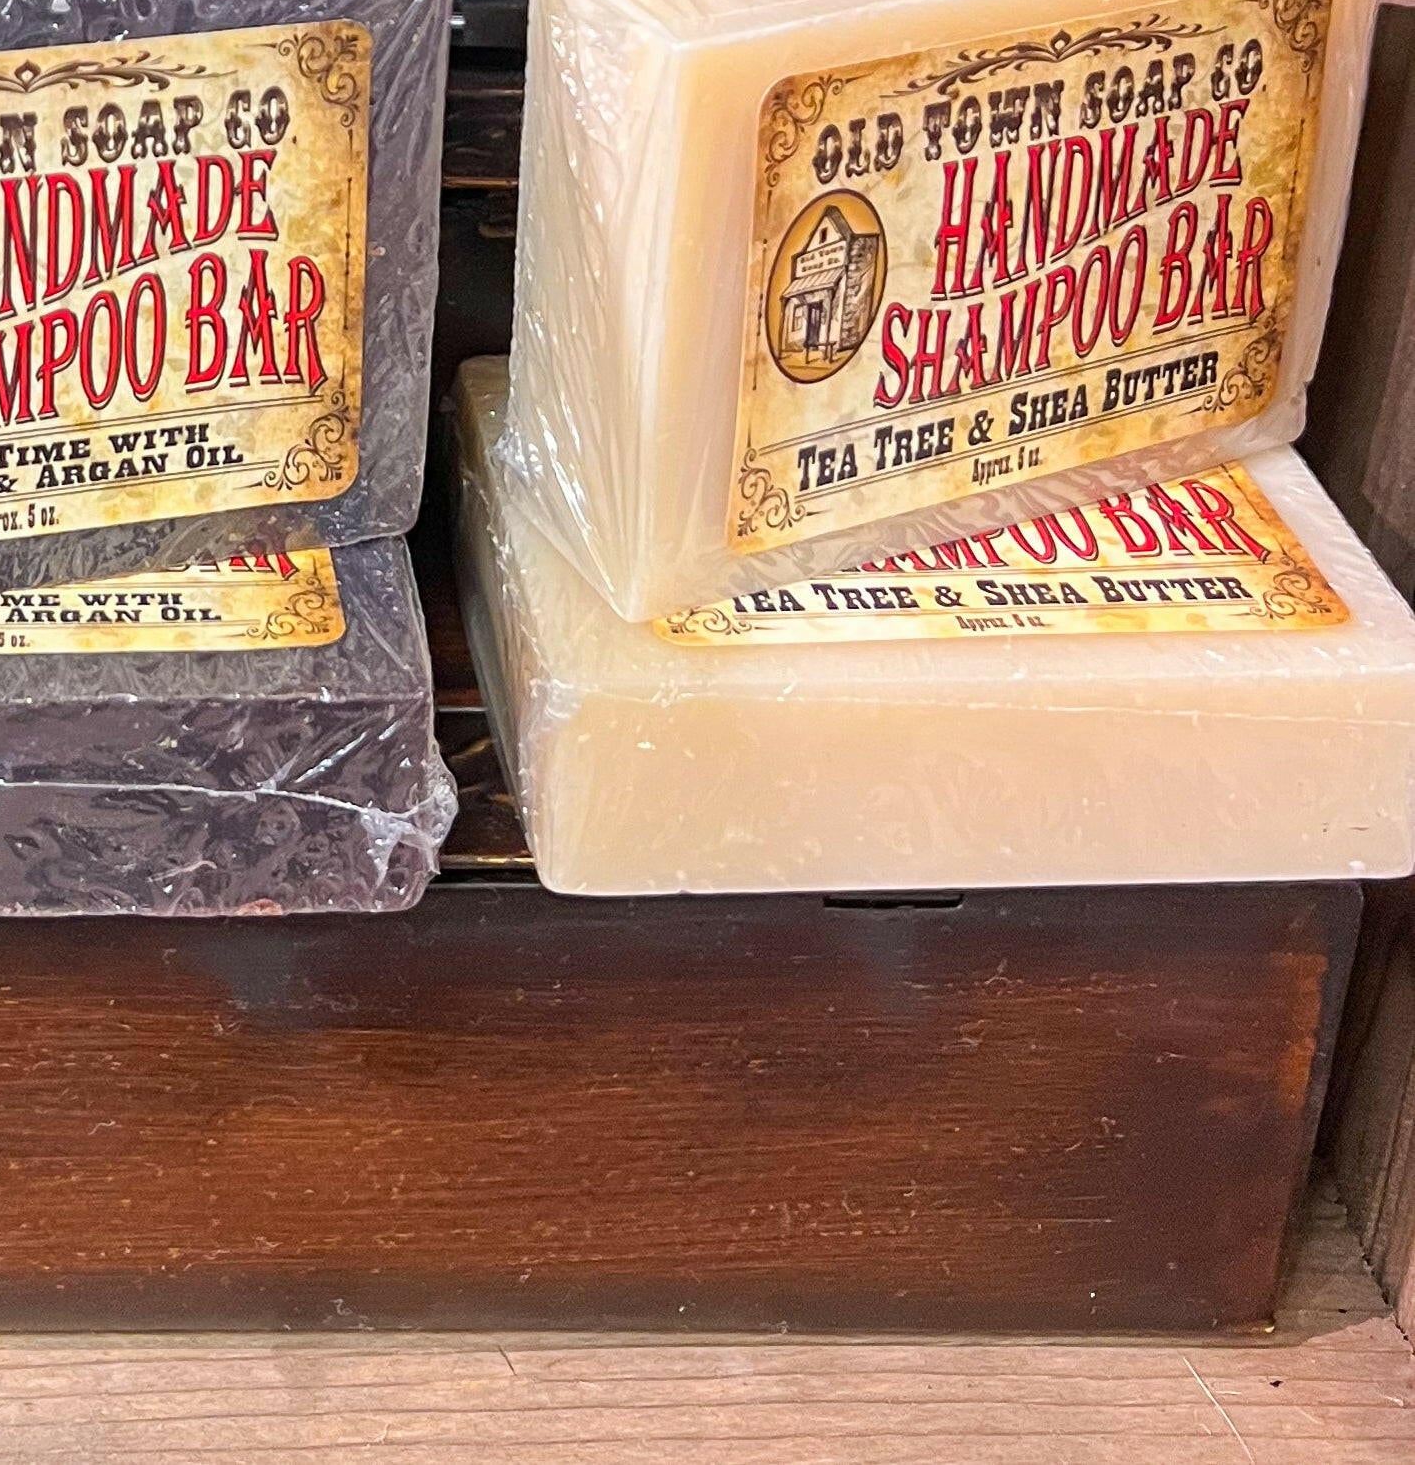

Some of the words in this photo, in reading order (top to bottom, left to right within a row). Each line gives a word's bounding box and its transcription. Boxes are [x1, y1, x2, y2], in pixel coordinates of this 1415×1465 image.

[61, 96, 205, 166] SOAP
[224, 84, 298, 147] CO.
[812, 113, 904, 186] OLD
[923, 79, 1065, 161] TOWN
[1080, 51, 1195, 129] SOAP
[1212, 37, 1266, 95] CO.
[930, 99, 1250, 302] HANDMADE
[184, 249, 329, 397] BAR
[872, 228, 1148, 409] SHAMPOO
[1152, 194, 1275, 336] BAR
[106, 422, 212, 453] WITH
[796, 445, 859, 492] TEA
[873, 416, 956, 472] TREE
[967, 409, 993, 448] &
[1008, 382, 1089, 437] SHEA
[1104, 350, 1220, 411] BUTTER
[35, 457, 169, 492] ARGAN
[185, 443, 244, 471] OIL
[27, 503, 36, 528] 5
[41, 505, 60, 527] oz.
[1098, 479, 1272, 565] BAR
[5, 607, 142, 623] ARGAN
[161, 607, 222, 622] OIL
[78, 593, 184, 607] WITH
[811, 583, 921, 611] TREE
[934, 585, 970, 608] &
[976, 579, 1089, 606] SHEA
[1090, 574, 1253, 603] BUTTER
